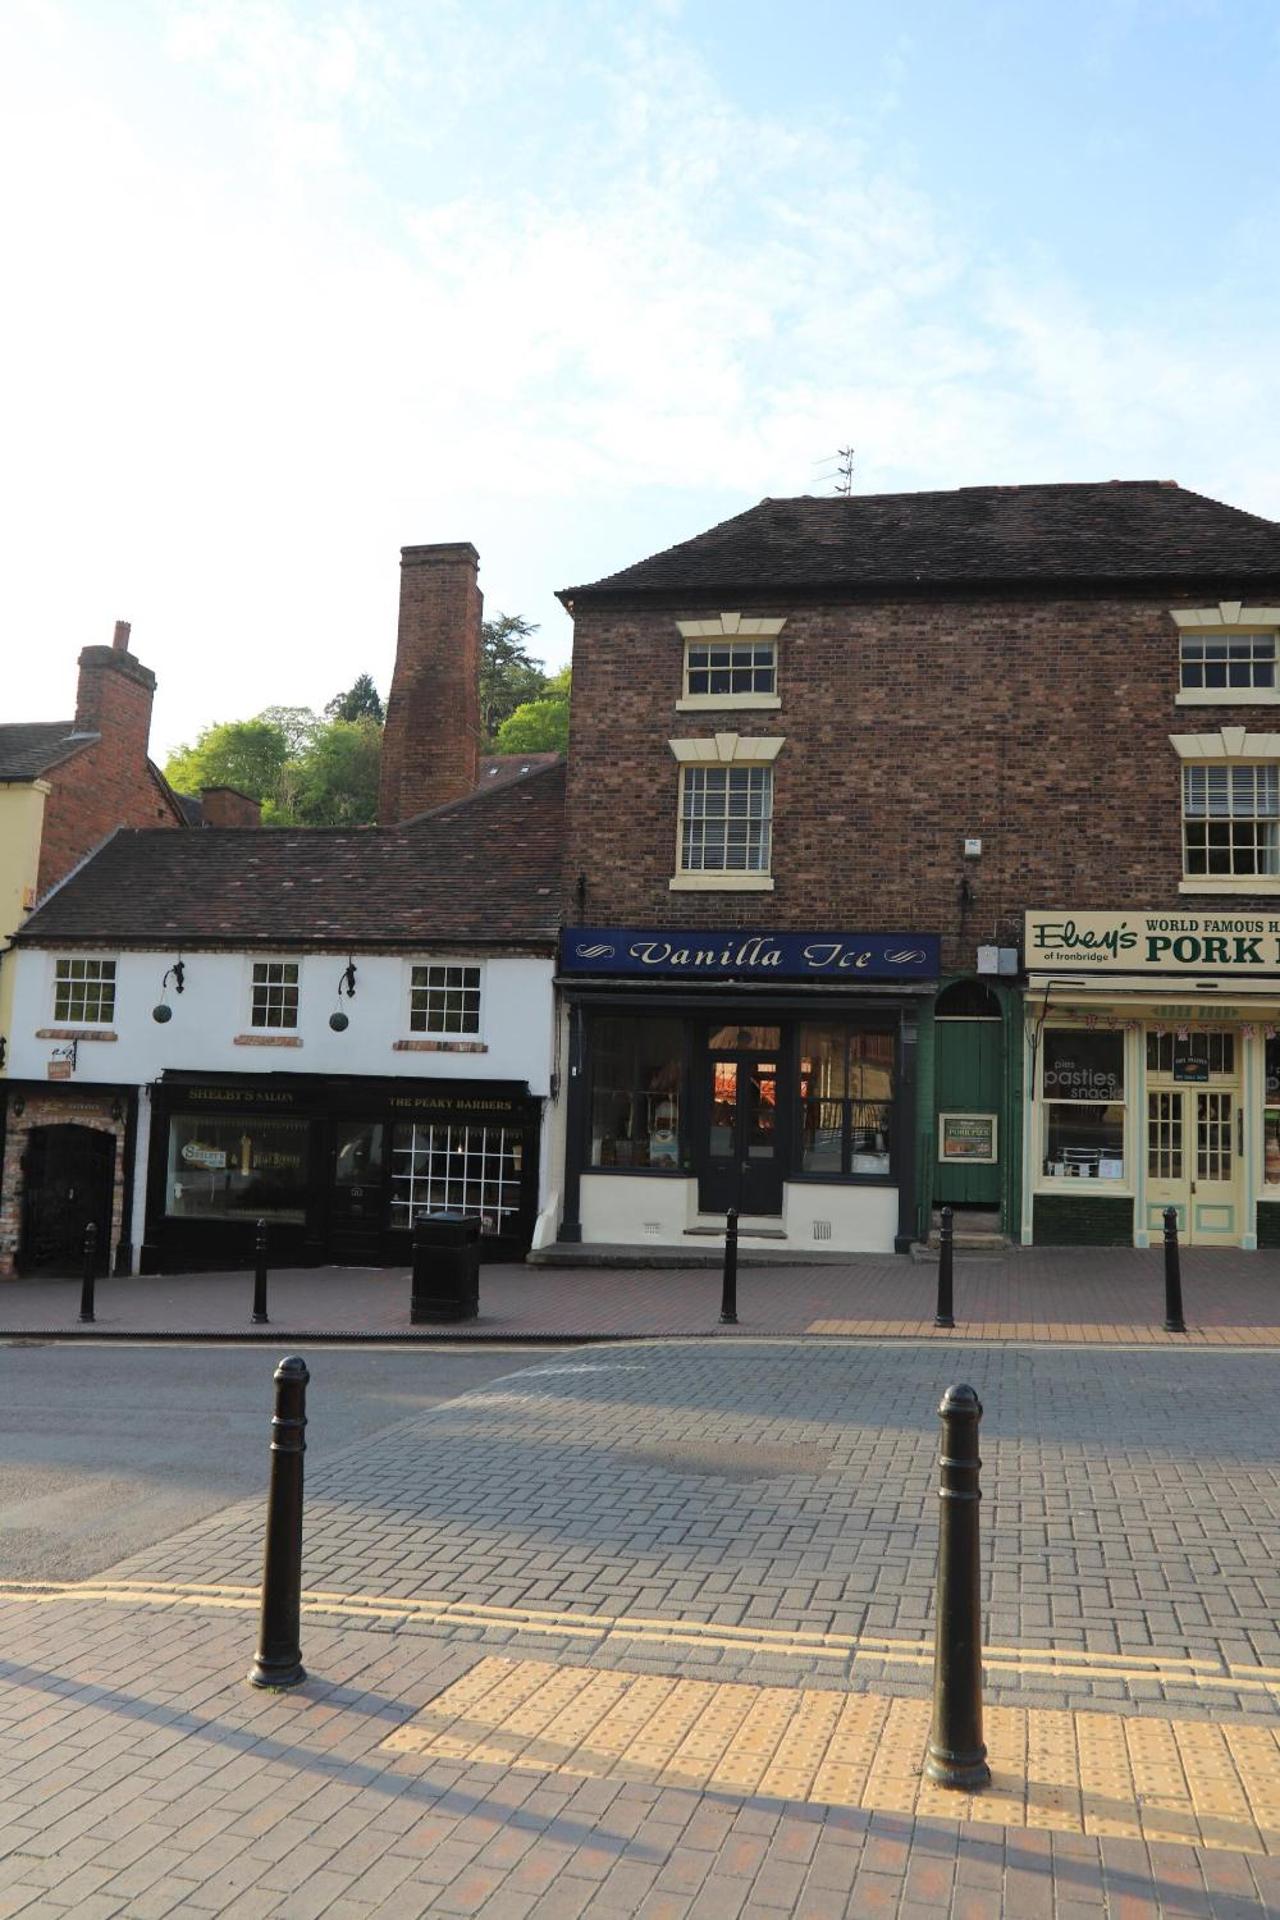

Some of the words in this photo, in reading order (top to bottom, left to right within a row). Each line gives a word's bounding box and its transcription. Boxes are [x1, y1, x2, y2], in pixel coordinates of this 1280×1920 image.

[1145, 919, 1199, 931] WORLD
[1204, 920, 1264, 932] FAMOUS
[630, 937, 783, 966] Vanilla
[804, 944, 872, 967] Ice
[1044, 952, 1053, 960] of
[1056, 952, 1109, 962] Ironbridge
[1145, 935, 1265, 963] PORK
[1045, 1068, 1117, 1087] pasties
[389, 1097, 412, 1107] THE
[414, 1098, 453, 1109] PEAKY
[456, 1100, 513, 1111] BARBERS
